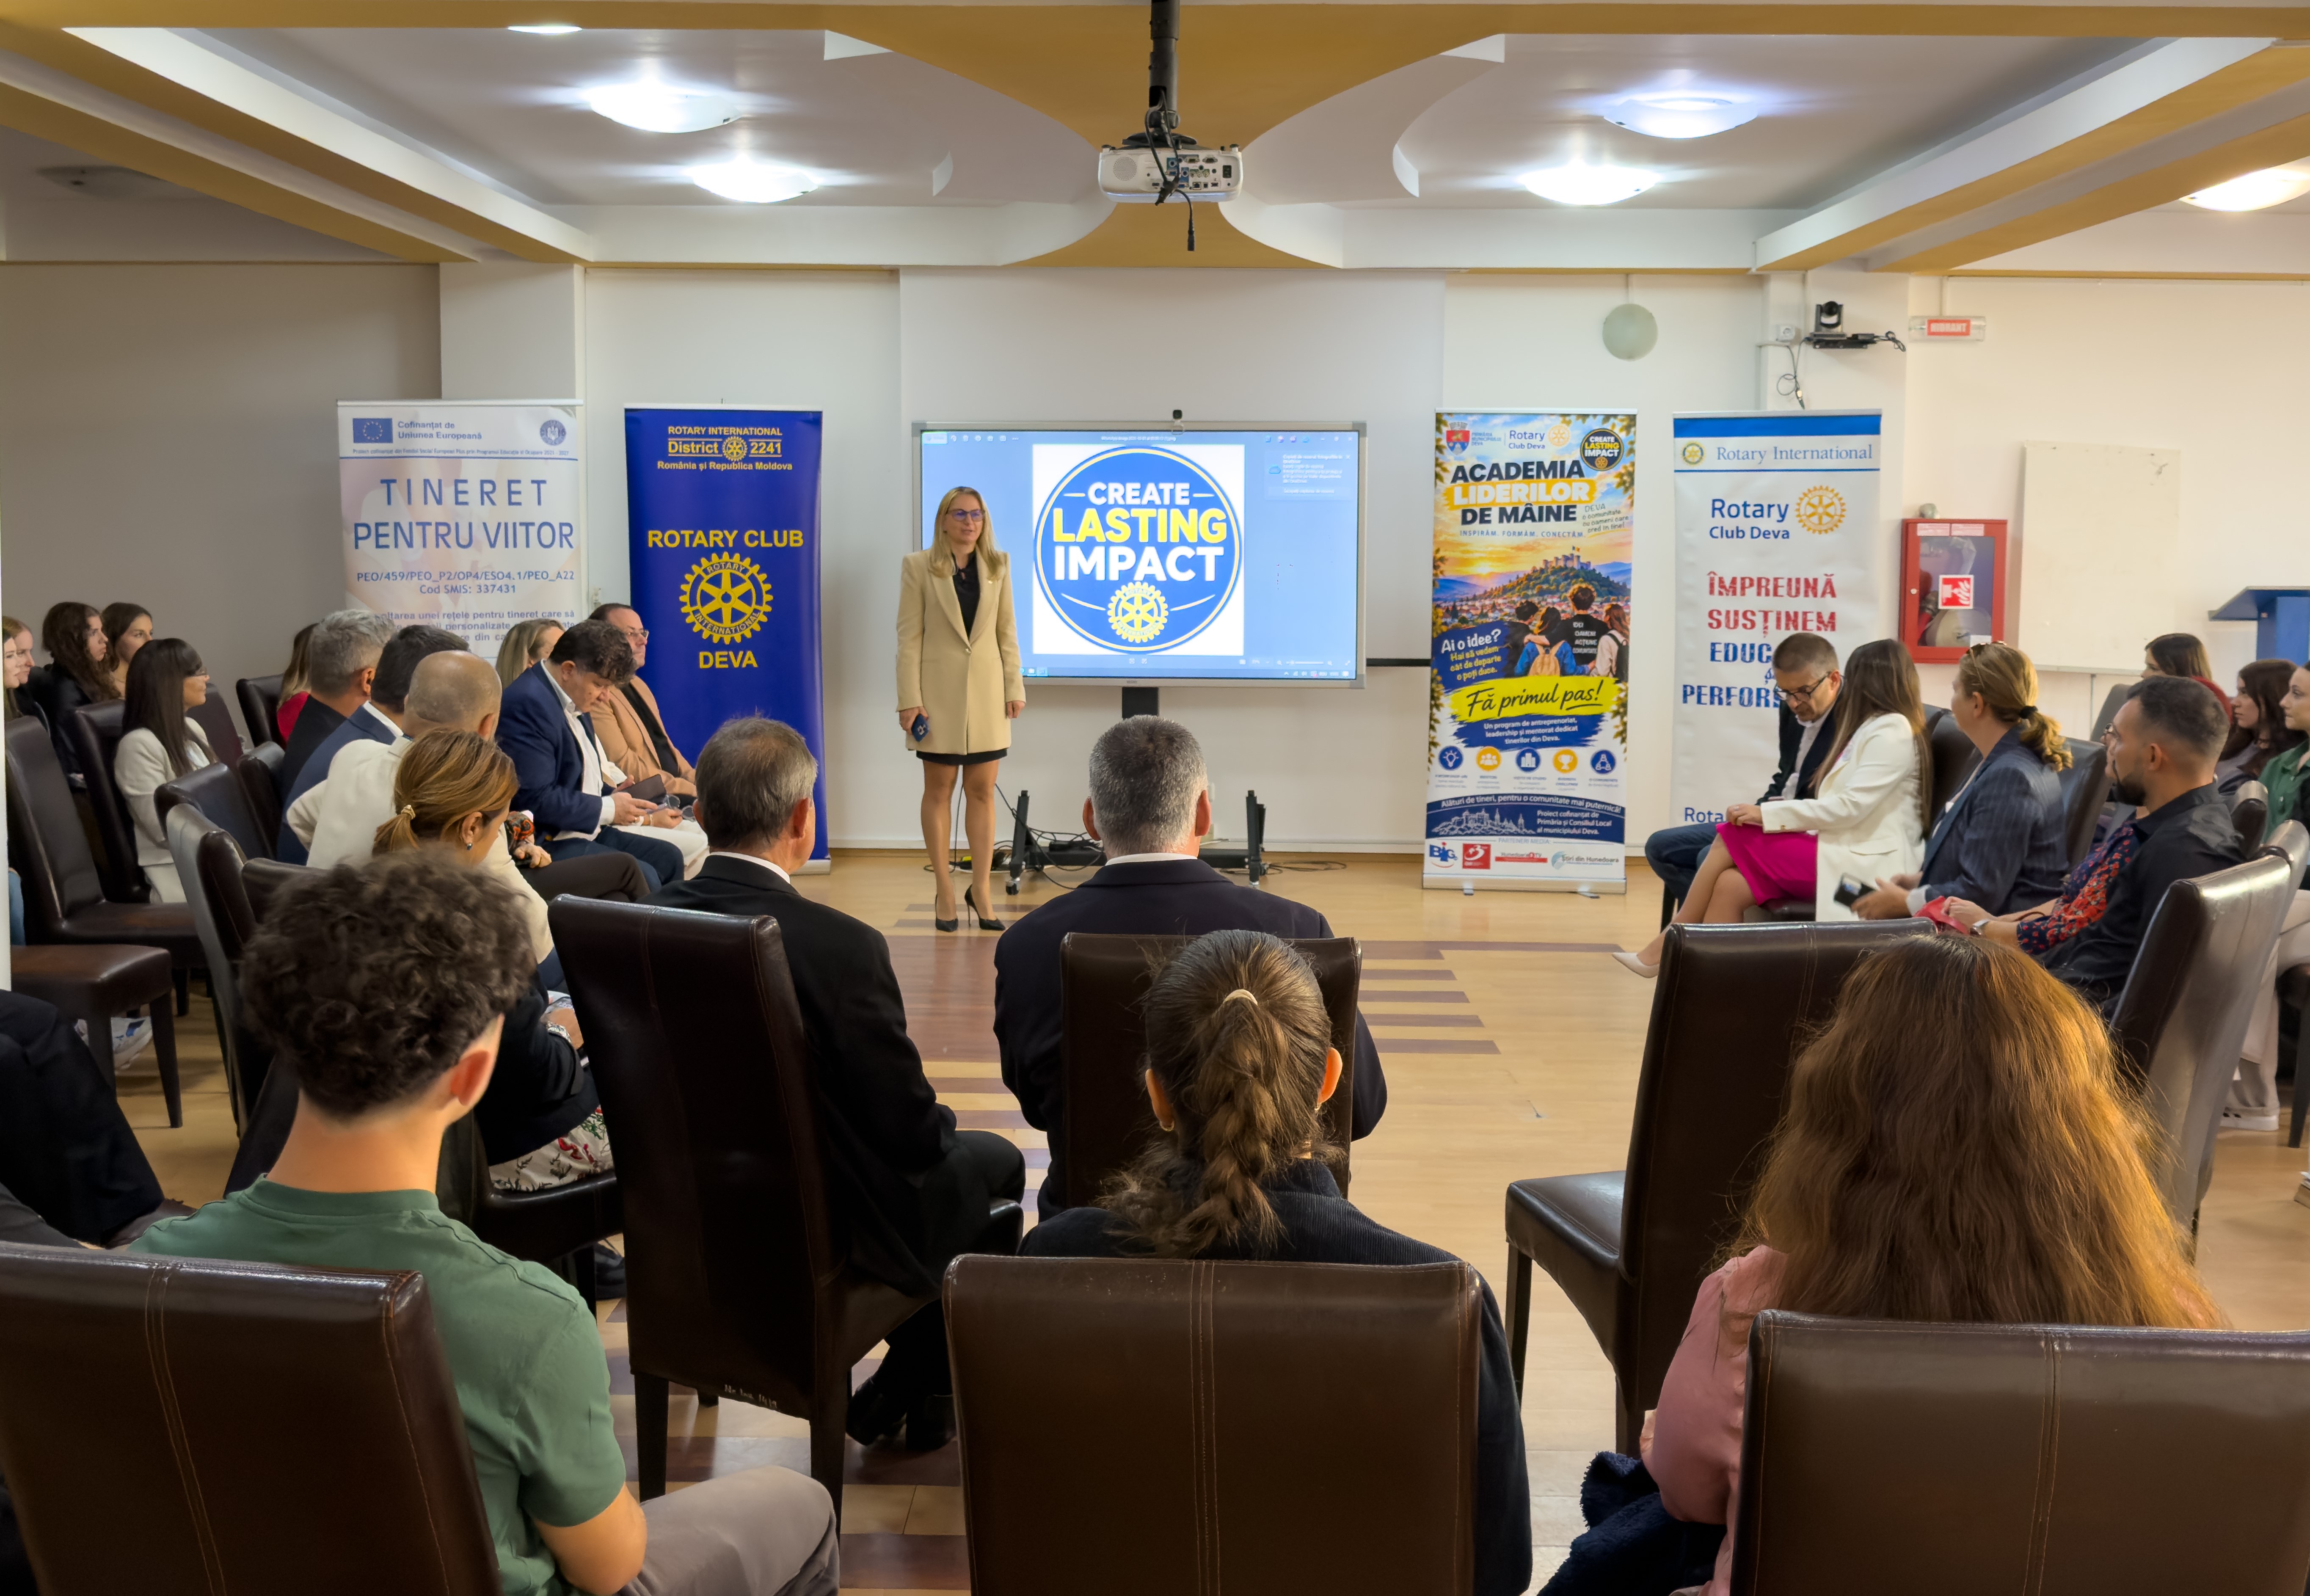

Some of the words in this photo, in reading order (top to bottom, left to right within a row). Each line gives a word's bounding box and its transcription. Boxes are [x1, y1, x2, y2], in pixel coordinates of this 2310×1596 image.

[397, 421, 442, 430] Cofinanțat
[668, 426, 706, 435] ROTARY
[708, 427, 783, 436] INTERNATIONAL
[436, 432, 482, 440] Europeană
[1509, 430, 1545, 441] Rotary
[668, 441, 718, 454] District
[750, 442, 781, 454] 2241
[1717, 447, 1767, 465] Rotary
[1773, 444, 1872, 460] International
[657, 460, 697, 470] România
[699, 461, 706, 471] și
[709, 460, 753, 471] Republica
[755, 462, 792, 470] Moldova
[1450, 460, 1585, 484] ACADEMIA
[380, 479, 547, 506] TINERET
[1087, 482, 1190, 505] CREATE
[1453, 482, 1590, 506] LIDERILOR
[1461, 507, 1492, 526] DE
[1498, 503, 1577, 524] MÂINE
[1585, 503, 1605, 512] DEVA
[1712, 498, 1789, 523] Rotary
[1053, 508, 1227, 543] LASTING
[1709, 526, 1745, 539] Club
[1750, 526, 1790, 539] Deva
[354, 521, 473, 549] PENTRU
[482, 521, 574, 549] VIITOR
[648, 530, 738, 548] ROTARY
[744, 530, 804, 547] CLUB
[706, 562, 745, 574] ROTARY
[1054, 546, 1224, 582] IMPACT
[420, 584, 440, 594] Cod
[444, 584, 471, 594] SMIS:
[477, 584, 515, 594] 337431
[1706, 571, 1837, 598] ÎMPREUNĂ
[419, 611, 440, 620] unei
[443, 611, 469, 621] rețele
[473, 611, 504, 620] pentru
[507, 610, 538, 618] tineret
[695, 612, 760, 635] INTERNATIONAL
[1707, 609, 1836, 638] SUSȚINEM
[445, 622, 510, 631] personalizate
[475, 633, 490, 641] din
[1441, 639, 1455, 653] Ai
[1457, 640, 1465, 650] o
[1467, 628, 1501, 648] idee?
[699, 651, 758, 669] DEVA
[1710, 642, 1772, 664] EDUC
[1464, 660, 1473, 669] de
[1474, 656, 1502, 667] departe
[1466, 687, 1497, 717] Fă
[1497, 683, 1560, 716] primul
[1560, 679, 1604, 710] pas!
[1486, 730, 1518, 738] leadership
[1525, 727, 1554, 735] mentorat
[1494, 722, 1521, 730] program
[1441, 797, 1465, 808] Alături
[1476, 795, 1497, 803] tineri,
[1498, 795, 1522, 804] pentru
[1529, 796, 1570, 805] comunitate
[1571, 798, 1584, 806] mai
[1685, 807, 1724, 823] Rota
